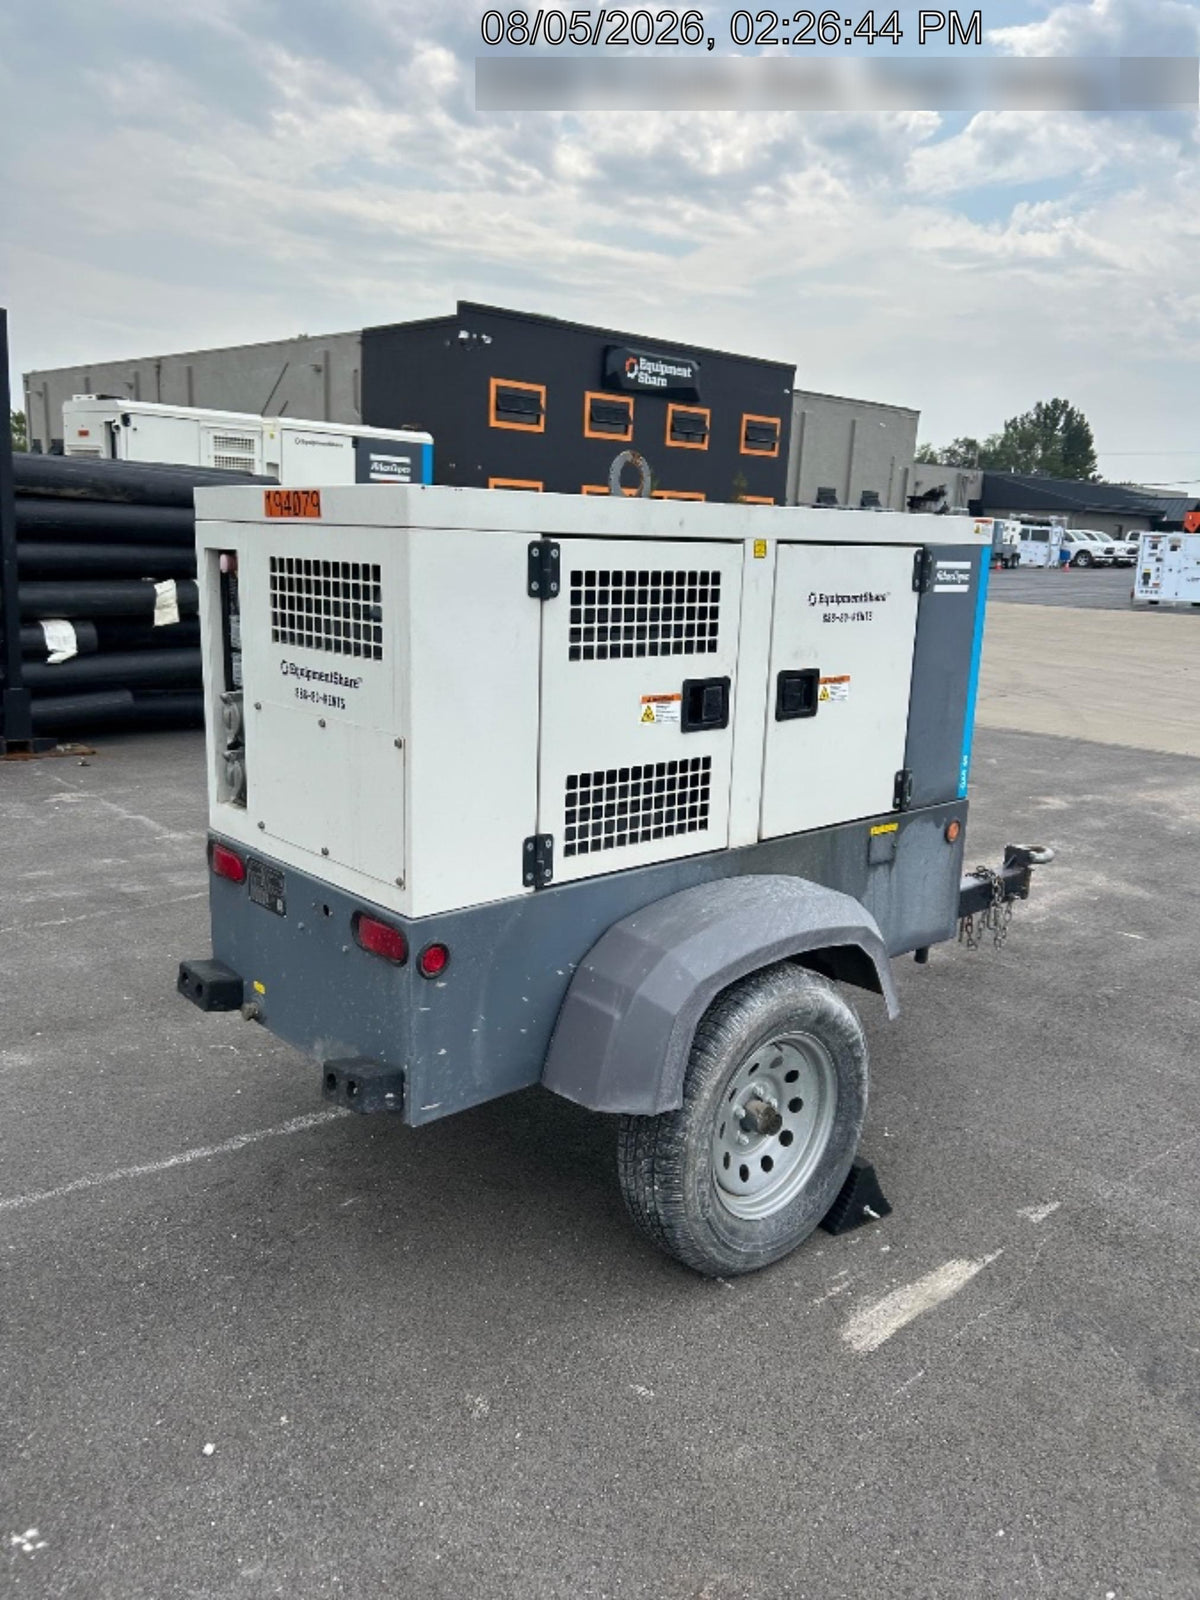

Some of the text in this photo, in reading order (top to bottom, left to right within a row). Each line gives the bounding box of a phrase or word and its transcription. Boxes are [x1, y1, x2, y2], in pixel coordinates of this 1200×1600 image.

[639, 357, 692, 378] Equipment
[638, 371, 668, 387] Share
[265, 490, 320, 516] 194079
